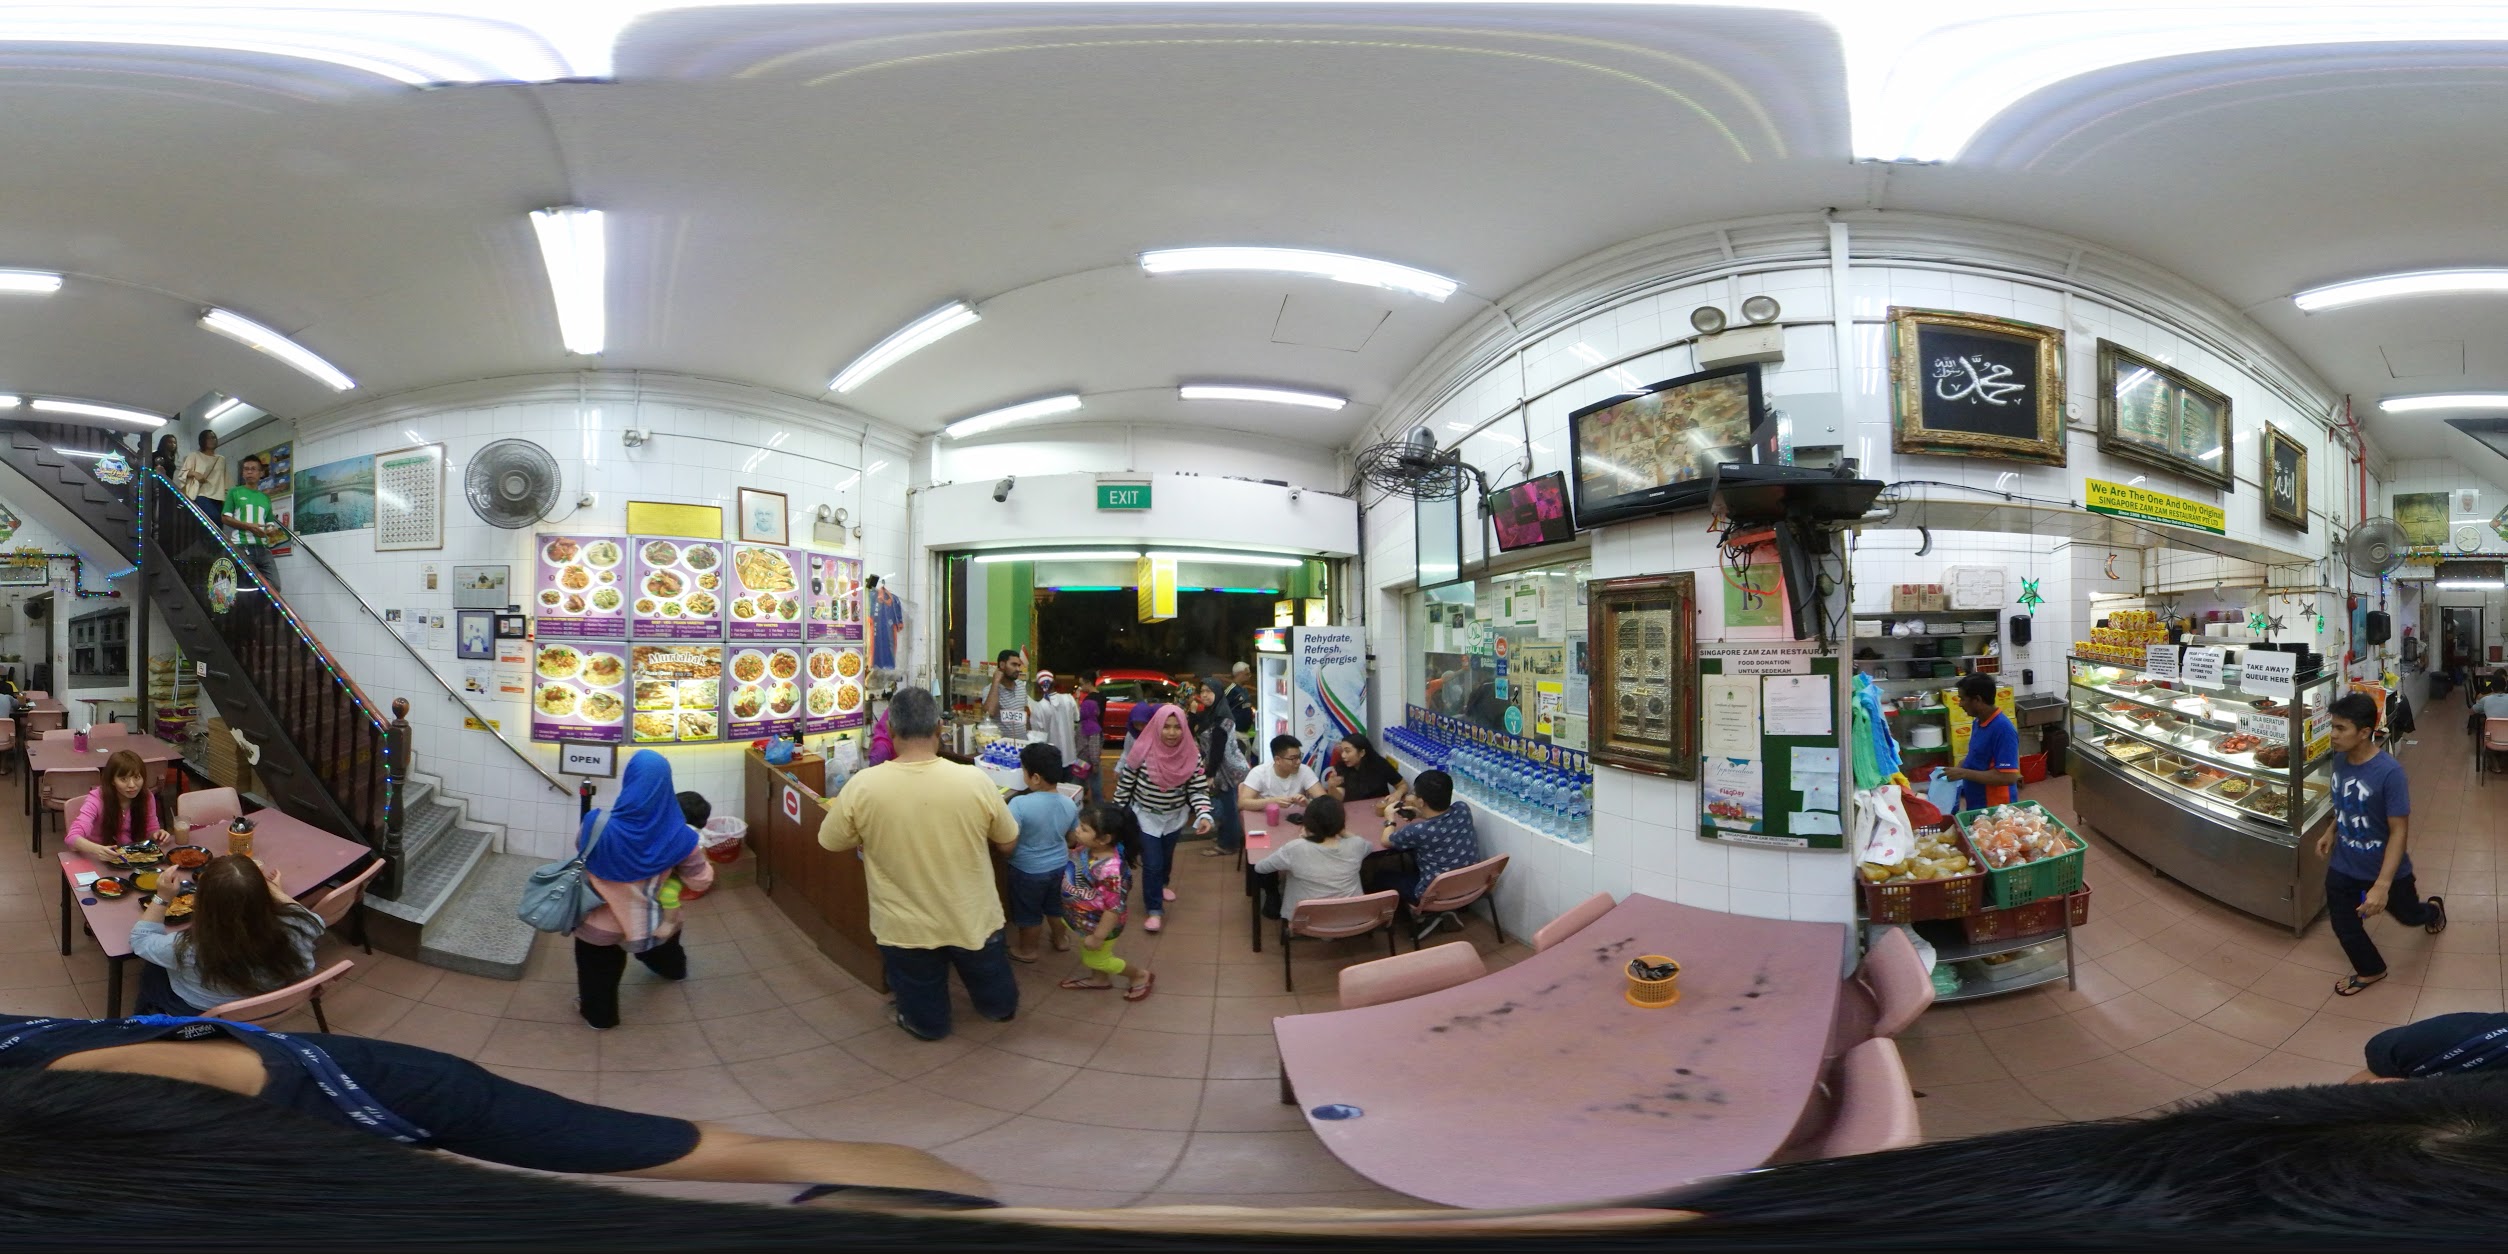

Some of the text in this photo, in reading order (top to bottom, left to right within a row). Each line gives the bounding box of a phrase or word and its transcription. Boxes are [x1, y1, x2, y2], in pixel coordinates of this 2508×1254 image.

[1110, 490, 1139, 504] EXIT
[2091, 483, 2223, 520] We Are The One And Only Original
[2099, 496, 2138, 510] SINGAPORE
[2140, 504, 2153, 512] ZAM
[2155, 506, 2168, 516] ZAM
[2169, 510, 2201, 522] RESTAURANT
[1304, 634, 1353, 644] Rehydrate,
[1304, 645, 1341, 654] Refresh,
[1465, 646, 1483, 654] HALAL
[1700, 648, 1740, 656] SINGAPORE
[648, 652, 706, 666] Murtabak
[1305, 655, 1357, 665] Re-energise
[2247, 664, 2289, 674] TAKE AWAY?
[2246, 673, 2289, 684] QUEUE HERE
[2252, 728, 2286, 740] PLEASE QUEUE
[570, 755, 600, 765] OPEN
